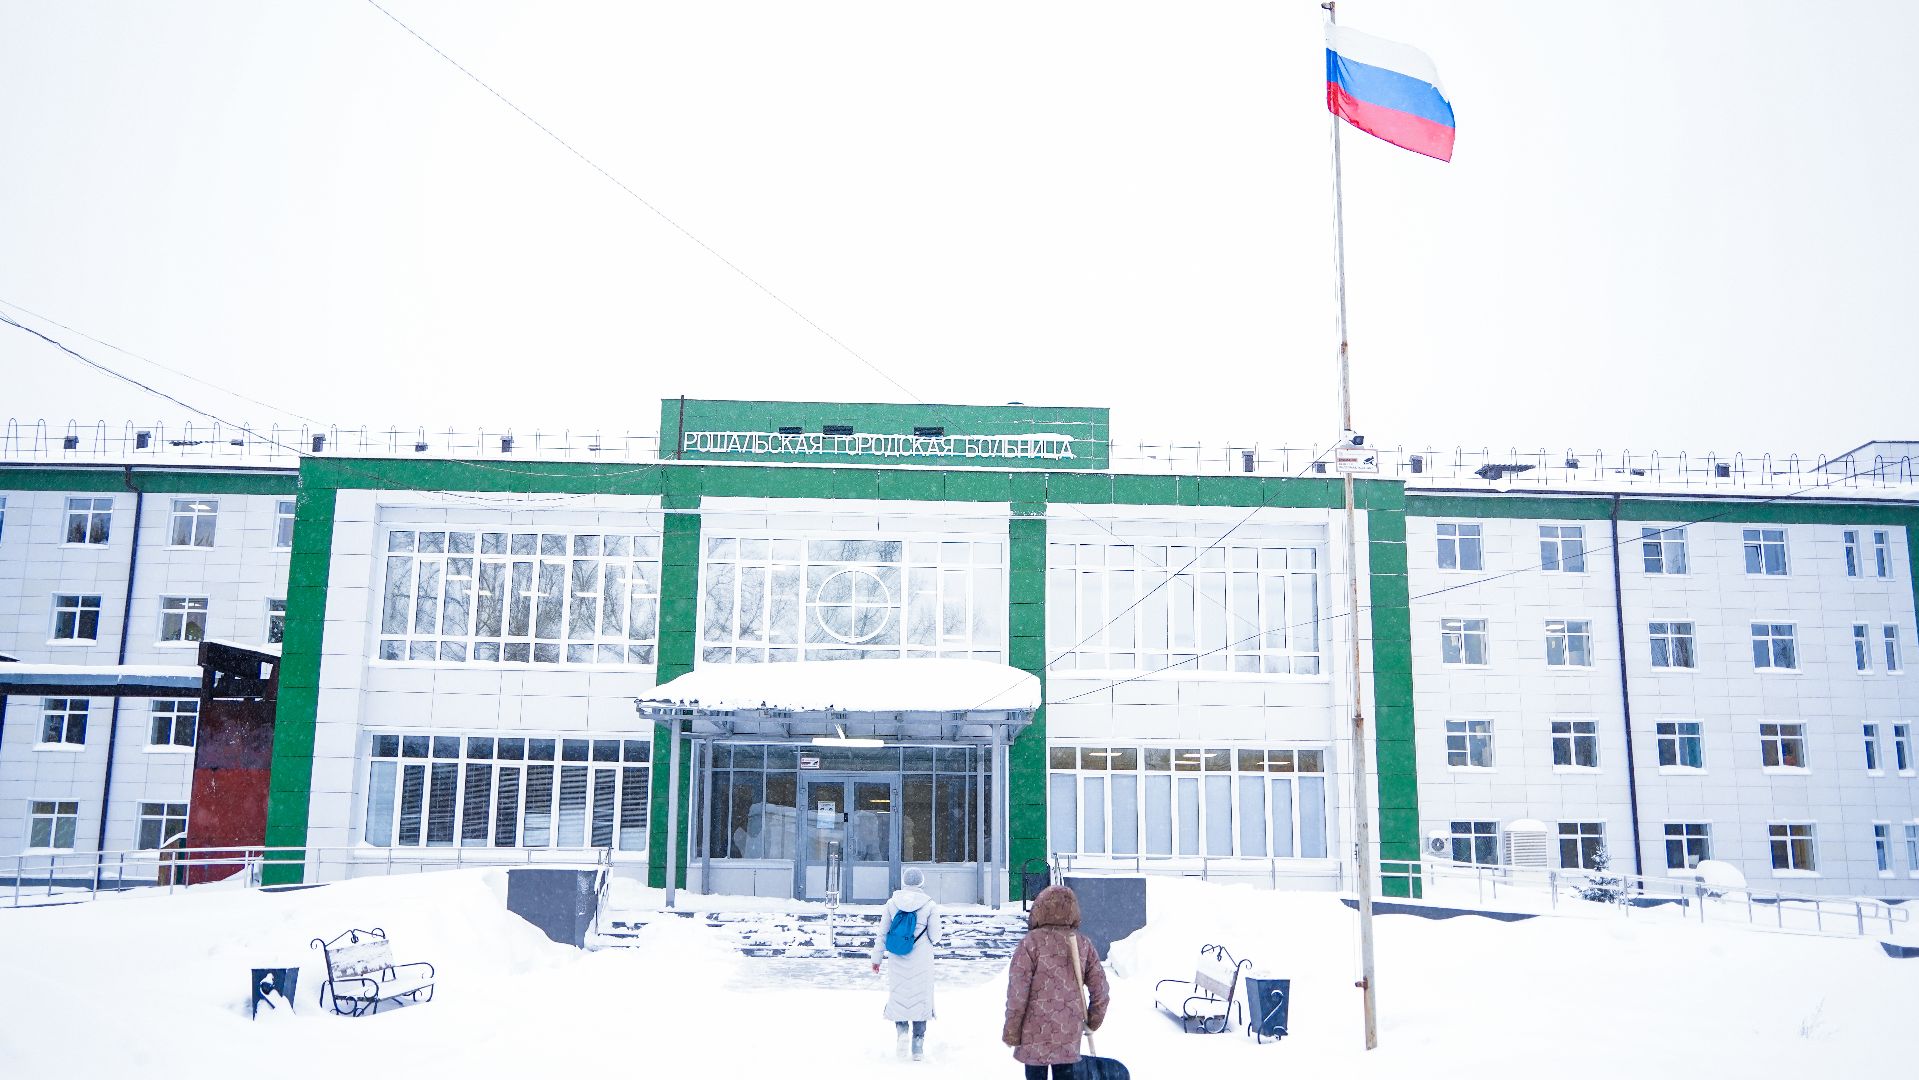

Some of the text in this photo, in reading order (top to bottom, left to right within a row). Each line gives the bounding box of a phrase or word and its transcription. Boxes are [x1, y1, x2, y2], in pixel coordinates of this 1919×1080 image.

[684, 432, 1075, 460] РОШАЛЬСКАЯ ГОРОДСКАЯ БОЛЬНИЦА
